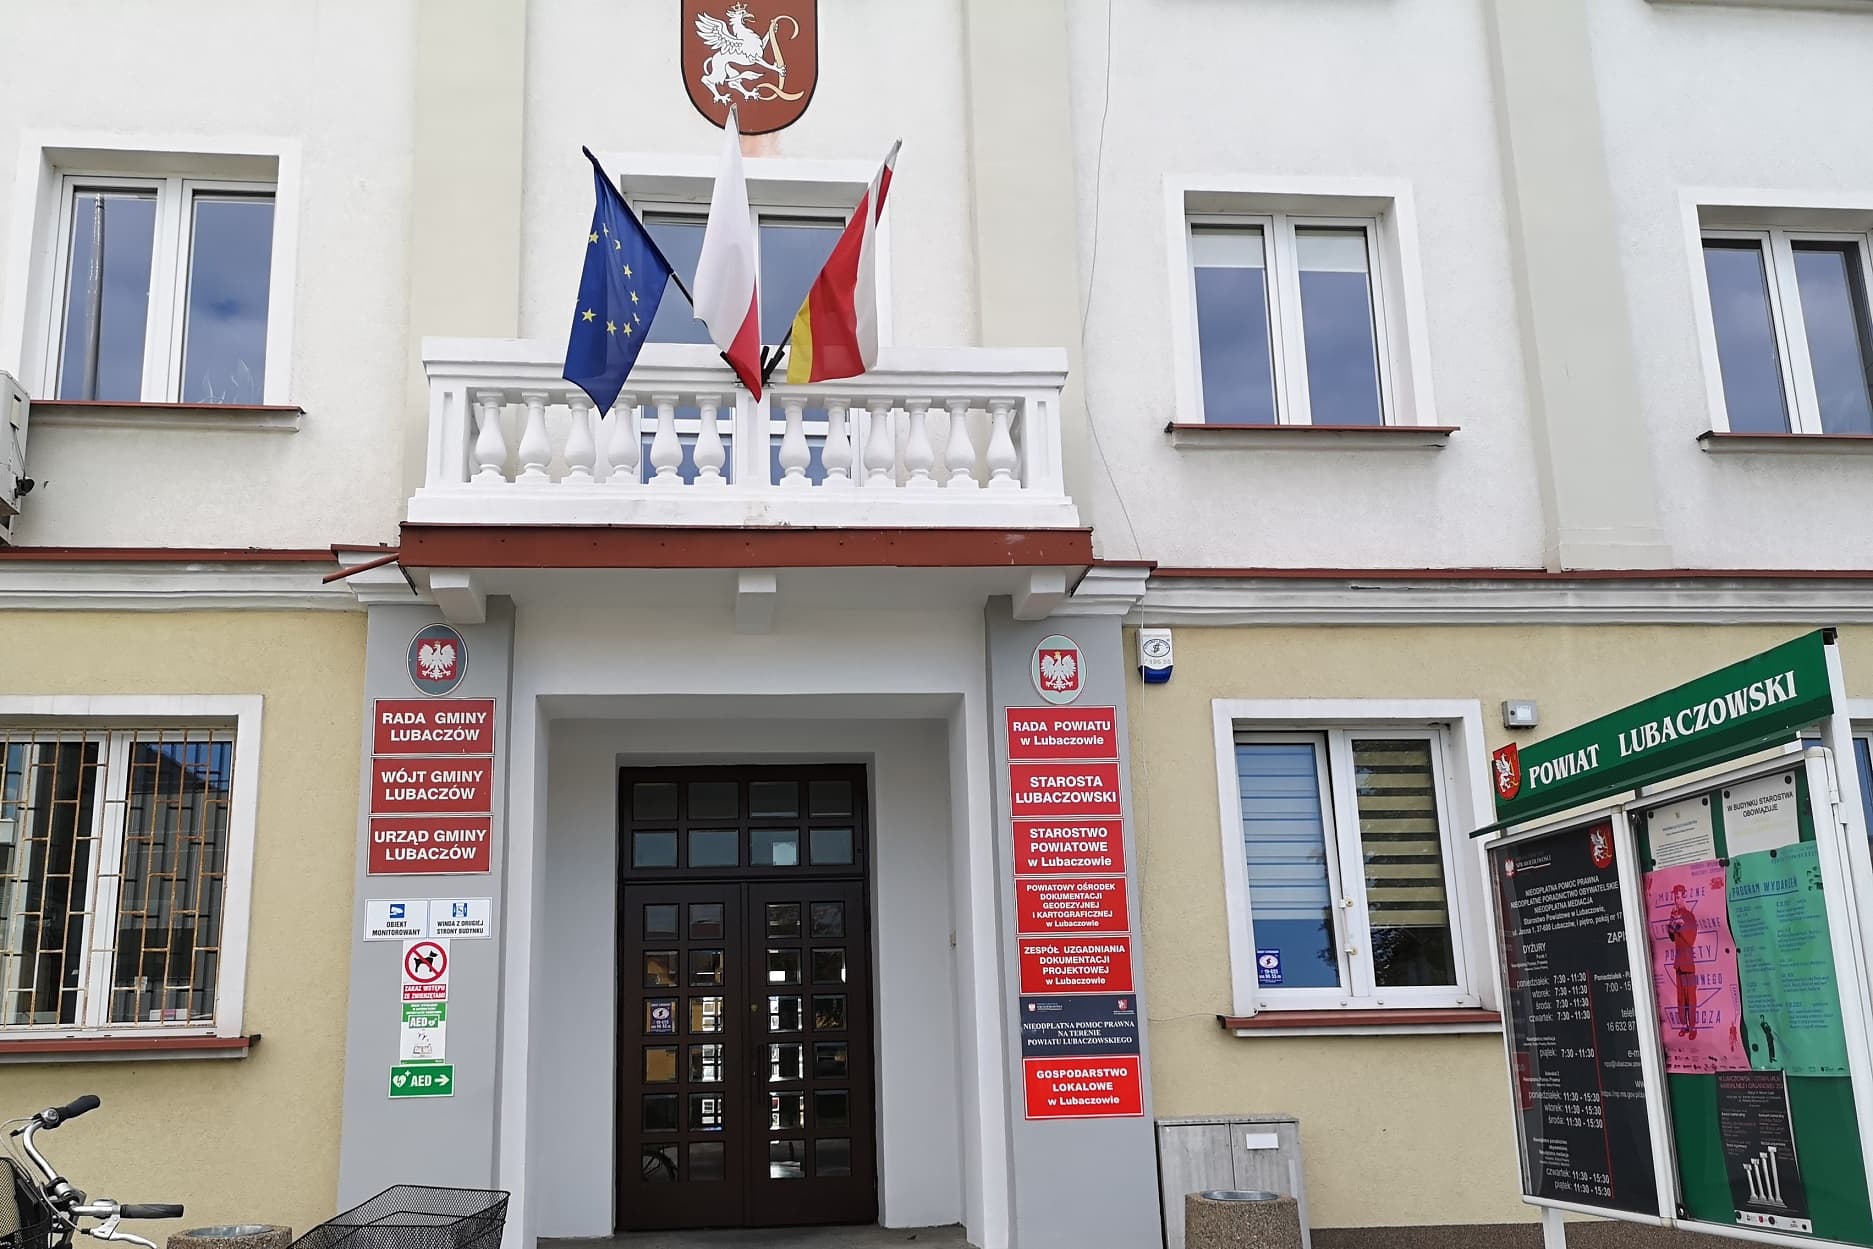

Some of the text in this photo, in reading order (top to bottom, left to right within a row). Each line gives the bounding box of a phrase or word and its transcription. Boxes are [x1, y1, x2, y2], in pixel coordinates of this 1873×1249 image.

[383, 712, 487, 724] RADA GMINY
[1013, 721, 1111, 731] RADA POWIATU
[1530, 670, 1798, 789] POWIAT LUBACZOWSKI
[390, 727, 479, 741] LUBACZÓW
[1021, 735, 1104, 745] w Lubaczowie
[381, 768, 483, 783] WÓJT GMINY
[1030, 776, 1103, 788] STAROSTA
[385, 785, 476, 801] LUBACZÓW
[1015, 792, 1117, 803] LUBACZOWSKI
[1733, 798, 1758, 811] BUDYNKU
[1759, 791, 1793, 806] STAROSTWA
[1743, 804, 1778, 818] OBOWIĄZUJE
[374, 829, 487, 845] URZĄD GMINY
[1029, 828, 1107, 839] STAROSTWO
[1030, 841, 1108, 852] POWIATOWE
[385, 845, 476, 861] LUBACZÓW
[1028, 856, 1112, 867] w Lubaczowie
[1076, 882, 1115, 890] OŚRODEK
[1558, 879, 1576, 891] POMOC
[1732, 882, 1760, 897] PROGRAM
[1037, 910, 1112, 918] KARTOGRAFICZNEJ
[1617, 912, 1622, 920] 17
[1607, 930, 1626, 943] ZAPI
[1024, 945, 1125, 954] ZESPÓŁ UZGADNIANIA
[1523, 942, 1546, 954] DYŻURY
[1040, 956, 1110, 965] DOKUMENTACJI
[1043, 966, 1109, 975] PROJEKTOWEJ
[1055, 977, 1105, 985] Lubaczowie
[410, 1018, 427, 1027] AED
[1076, 1021, 1103, 1029] POMOC
[1104, 1020, 1135, 1028] PRAWNA
[1615, 1021, 1627, 1031] 632
[1062, 1037, 1132, 1045] LUBACZOWSKIEGO
[1627, 1050, 1640, 1058] e-m
[1036, 1068, 1127, 1079] GOSPODARSTWO
[410, 1075, 432, 1087] AED
[1053, 1082, 1113, 1092] LOKALOWE
[1048, 1096, 1120, 1106] w Lubaczowie
